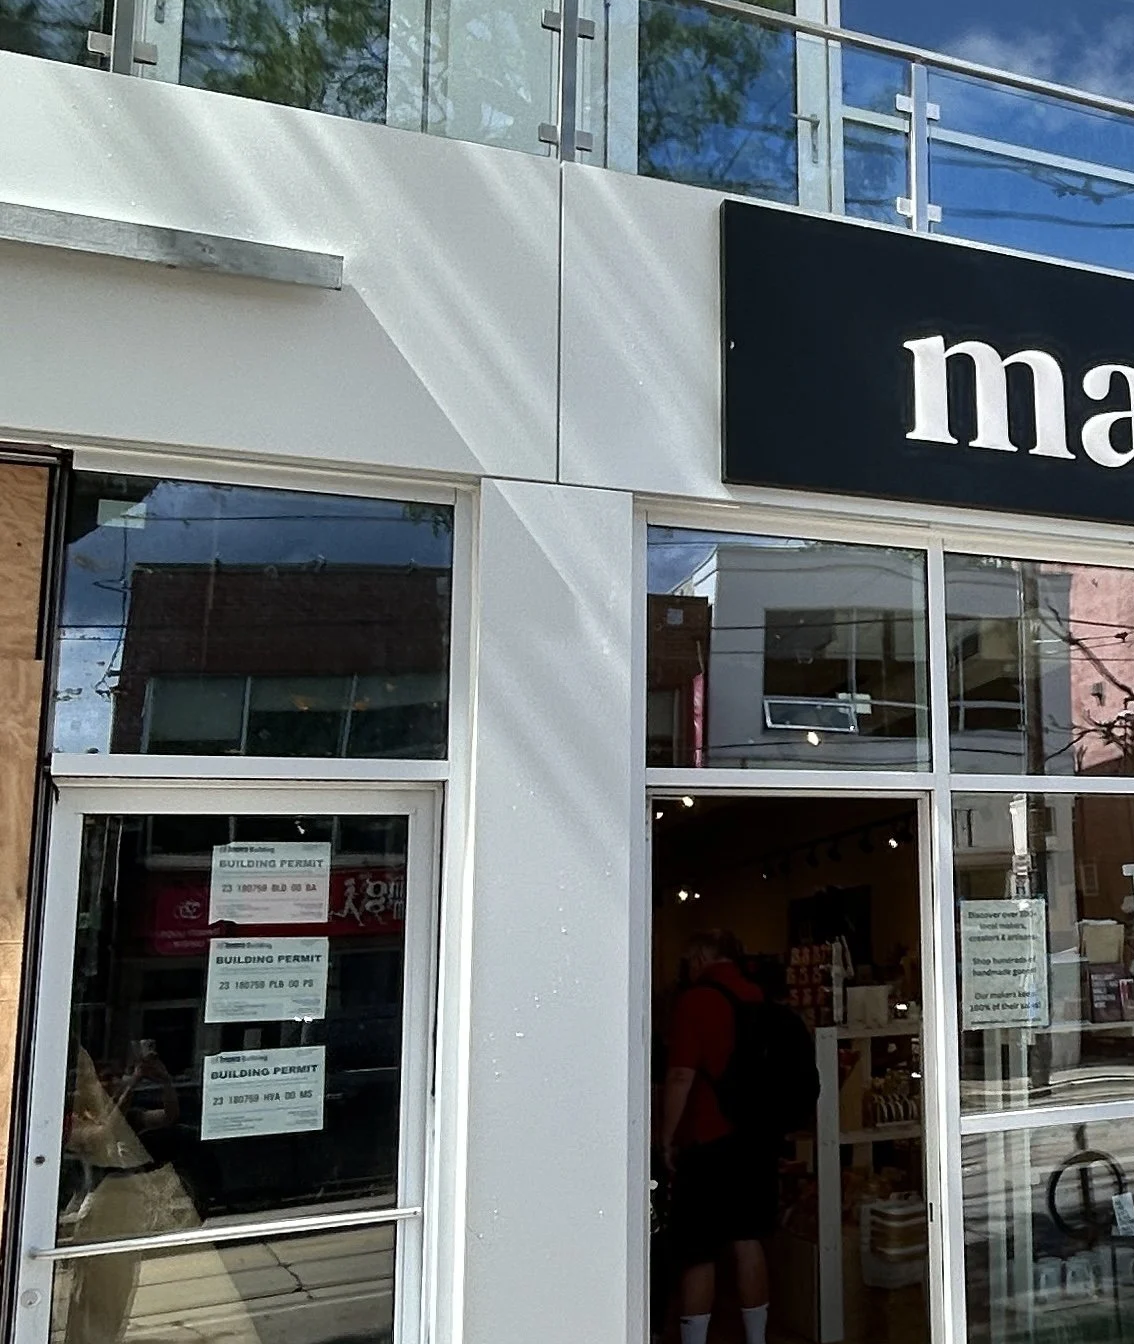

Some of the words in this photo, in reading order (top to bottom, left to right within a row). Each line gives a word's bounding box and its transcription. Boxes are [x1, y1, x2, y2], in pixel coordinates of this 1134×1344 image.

[219, 859, 276, 868] BUILDING
[280, 859, 324, 868] PERMIT
[222, 884, 232, 893] 23
[216, 955, 273, 964] BUILDING
[278, 955, 322, 964] PERMIT
[219, 981, 230, 990] 23
[210, 1067, 270, 1080] BUILDING
[273, 1064, 318, 1075] PERMIT
[213, 1097, 224, 1106] 23
